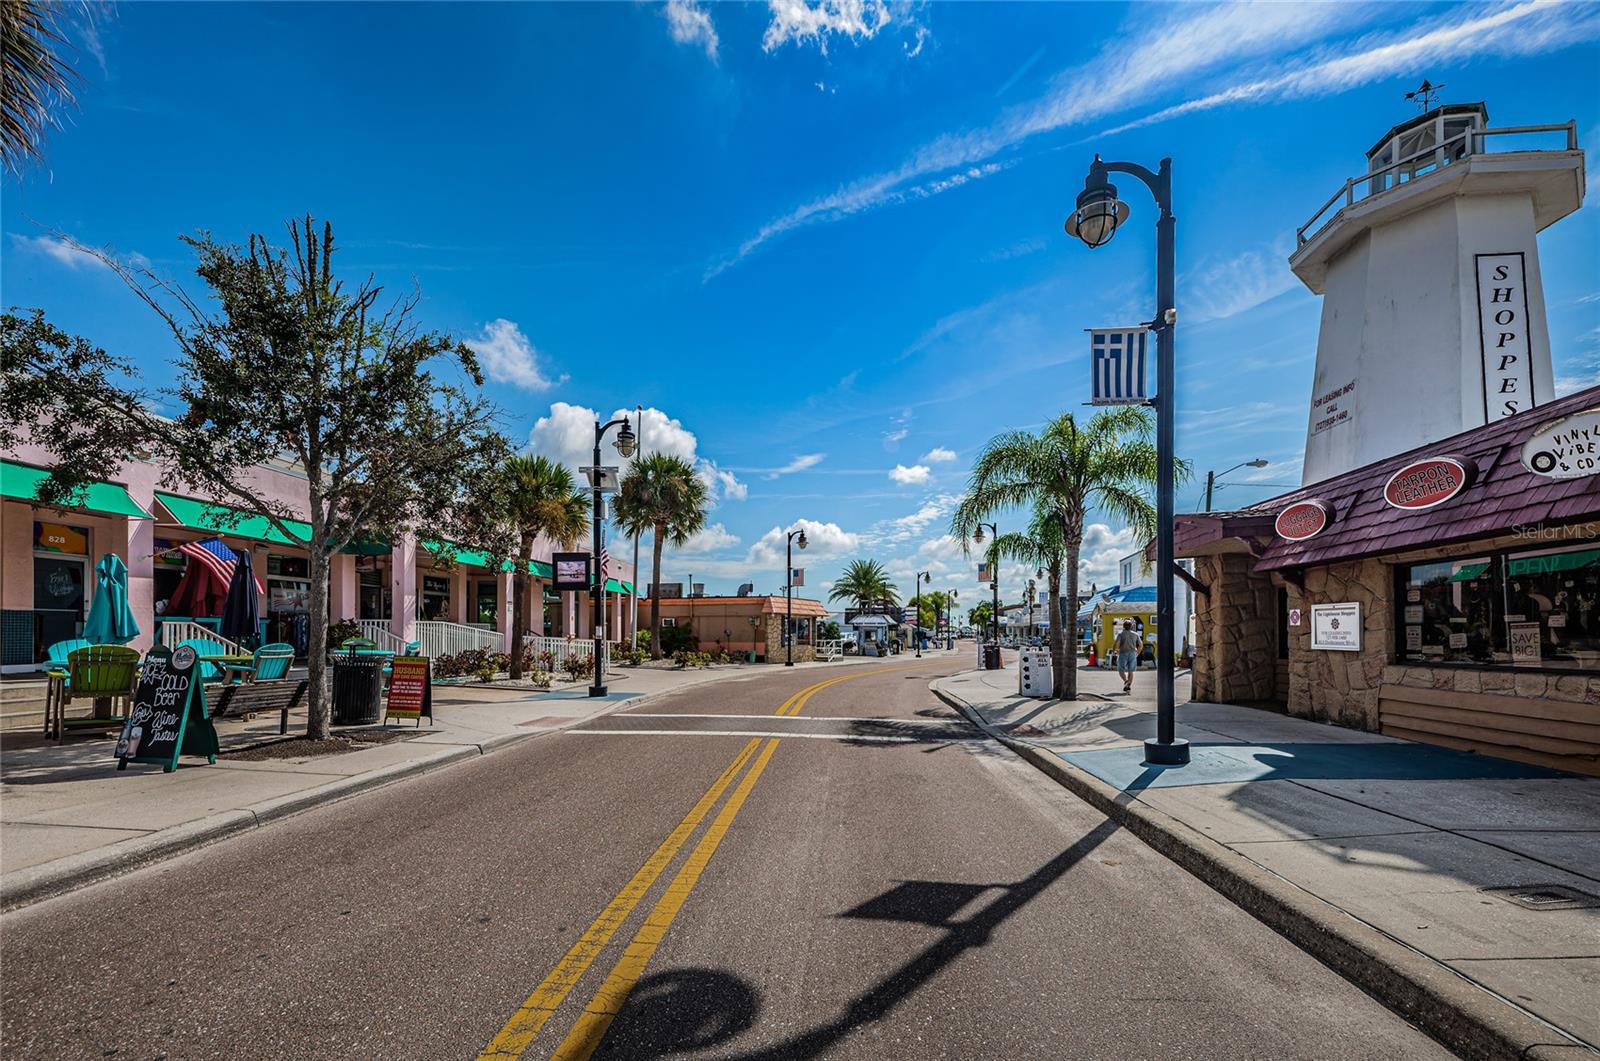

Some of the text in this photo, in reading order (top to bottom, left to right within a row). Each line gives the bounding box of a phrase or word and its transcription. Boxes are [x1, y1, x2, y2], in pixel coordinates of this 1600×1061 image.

[1491, 265, 1518, 417] SHOPPES
[1322, 388, 1342, 405] LEASING
[1326, 402, 1338, 414] CALL
[1553, 424, 1600, 446] VINYL
[1559, 462, 1571, 472] &
[1393, 463, 1451, 491] TARPON
[1394, 475, 1457, 504] LEATHER
[1280, 506, 1321, 530] LUGGAGE
[1287, 518, 1318, 537] OUTLET
[48, 535, 66, 544] 828
[1512, 632, 1539, 644] SAVE
[147, 655, 167, 663] Menu
[1515, 645, 1538, 657] BIG!
[161, 673, 189, 691] COLD
[153, 687, 180, 707] Beer
[151, 710, 179, 729] Wine
